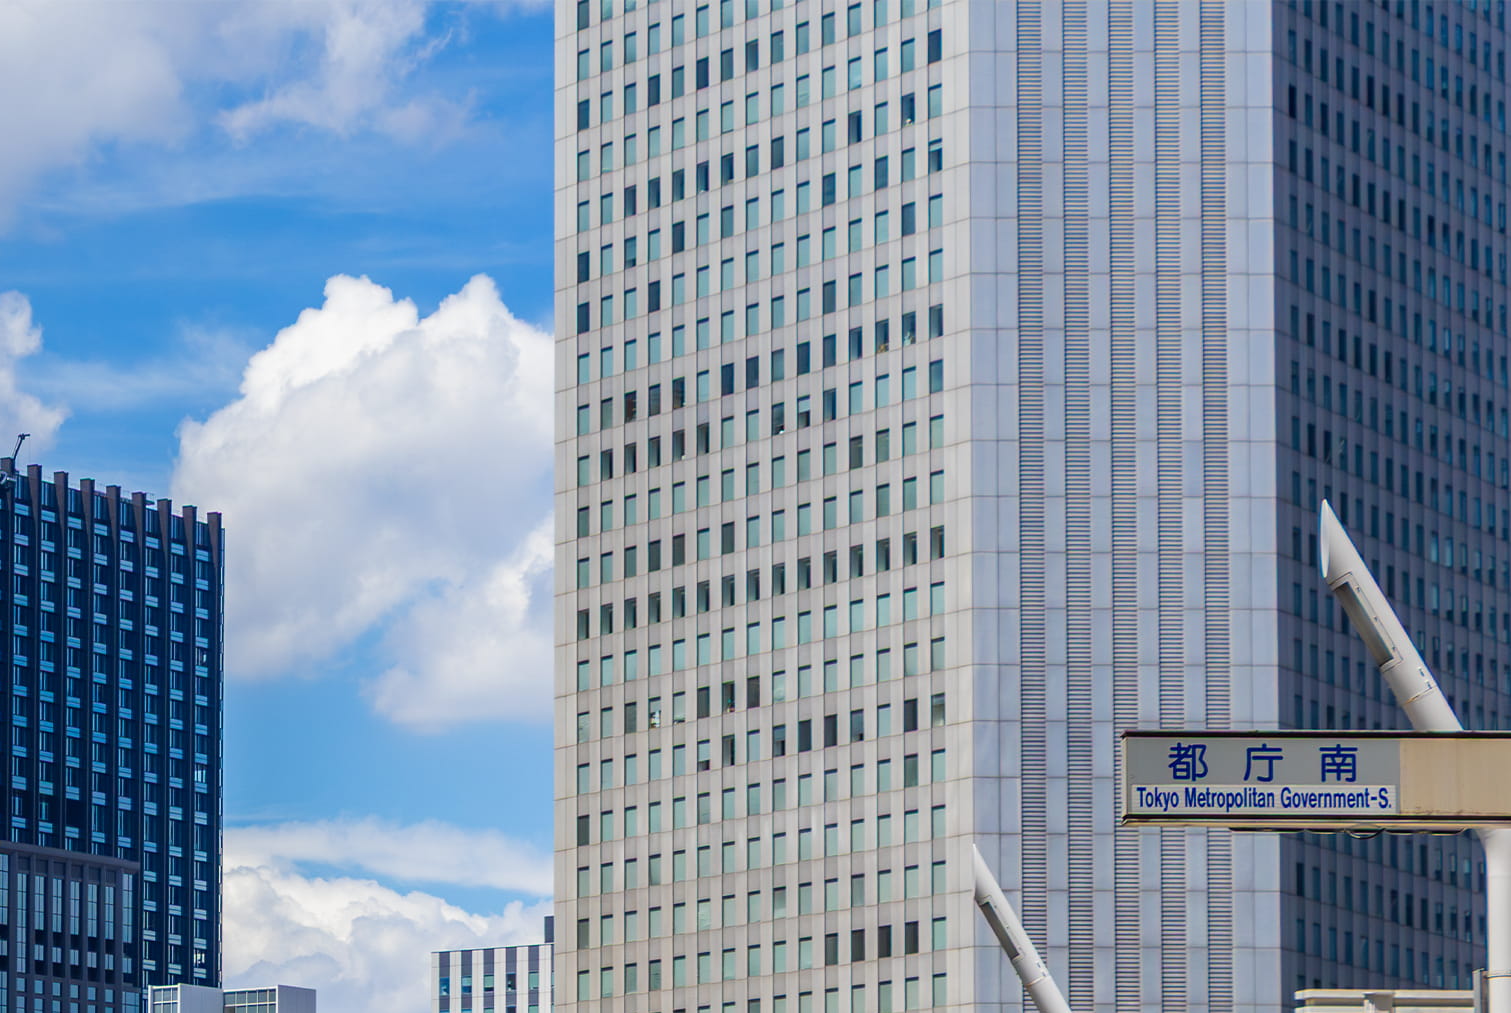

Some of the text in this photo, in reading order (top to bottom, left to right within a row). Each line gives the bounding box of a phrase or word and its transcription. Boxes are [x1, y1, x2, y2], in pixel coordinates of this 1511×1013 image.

[1168, 743, 1358, 782] 都庁南
[1137, 786, 1392, 813] Tokyo Metropolitan Government-S.
